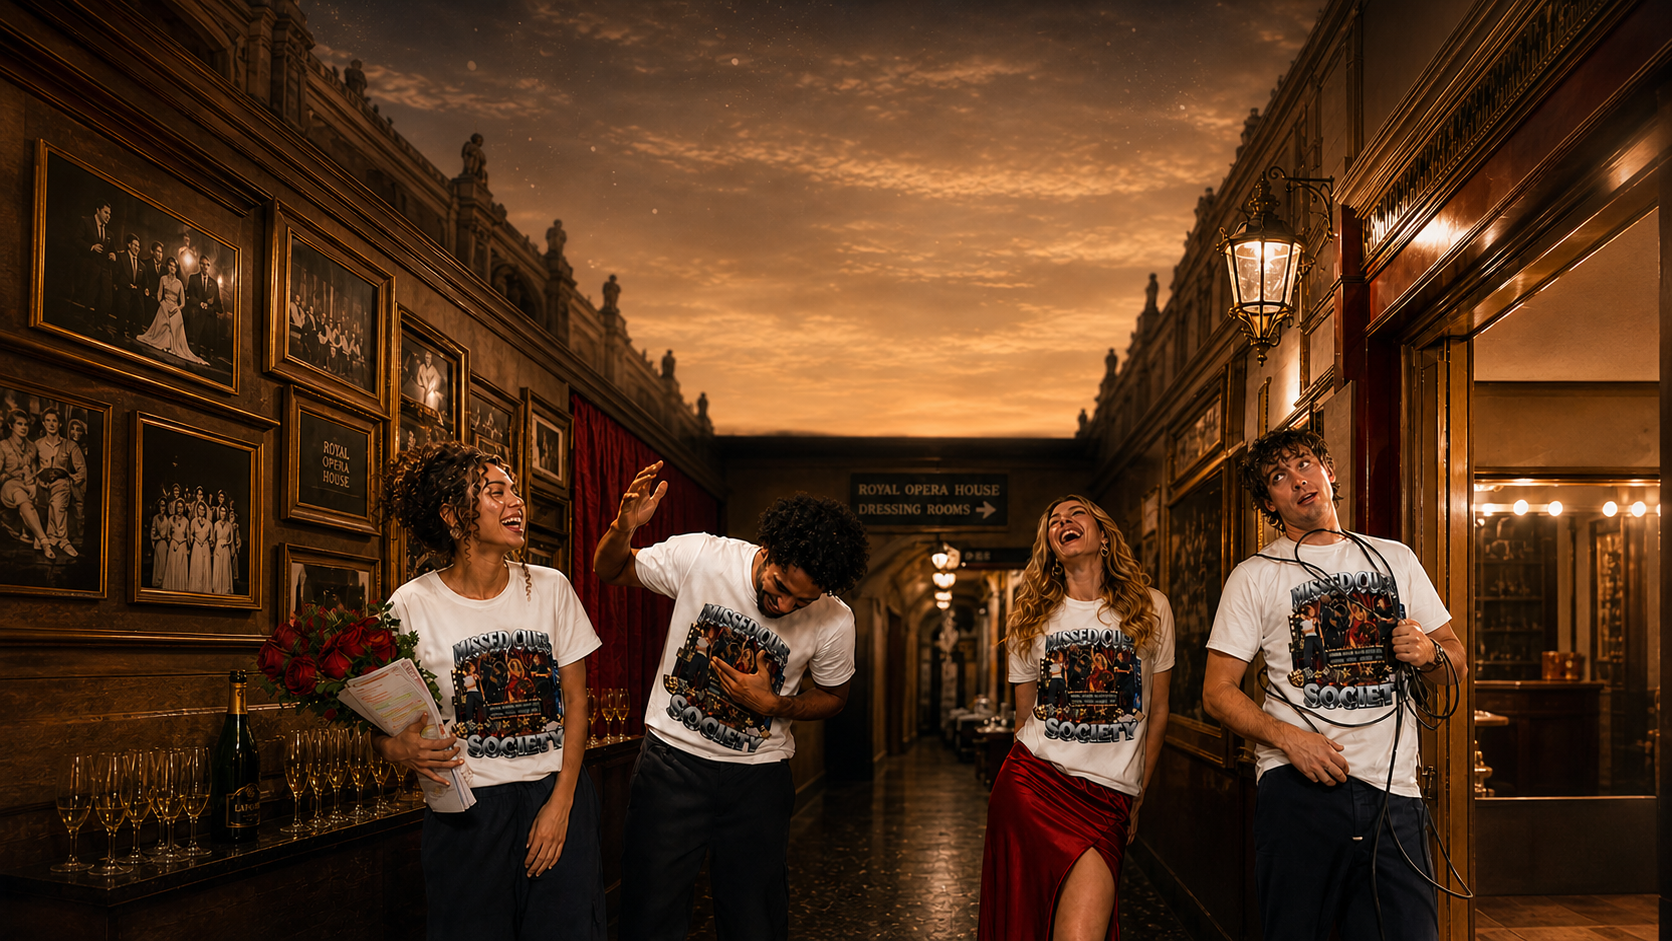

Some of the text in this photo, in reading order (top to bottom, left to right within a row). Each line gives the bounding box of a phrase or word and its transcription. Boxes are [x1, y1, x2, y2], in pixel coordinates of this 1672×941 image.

[323, 441, 350, 460] ROYAL
[322, 470, 350, 488] HOUSE
[858, 484, 1000, 496] ROYAL OPERA HOUSE
[858, 504, 971, 515] DRESSING ROOMS
[452, 630, 511, 667] MISSED
[1303, 683, 1397, 709] SOCIET
[666, 694, 766, 753] SOCIETY
[1045, 718, 1139, 743] SOCIETY
[467, 729, 564, 759] SOCIETY
